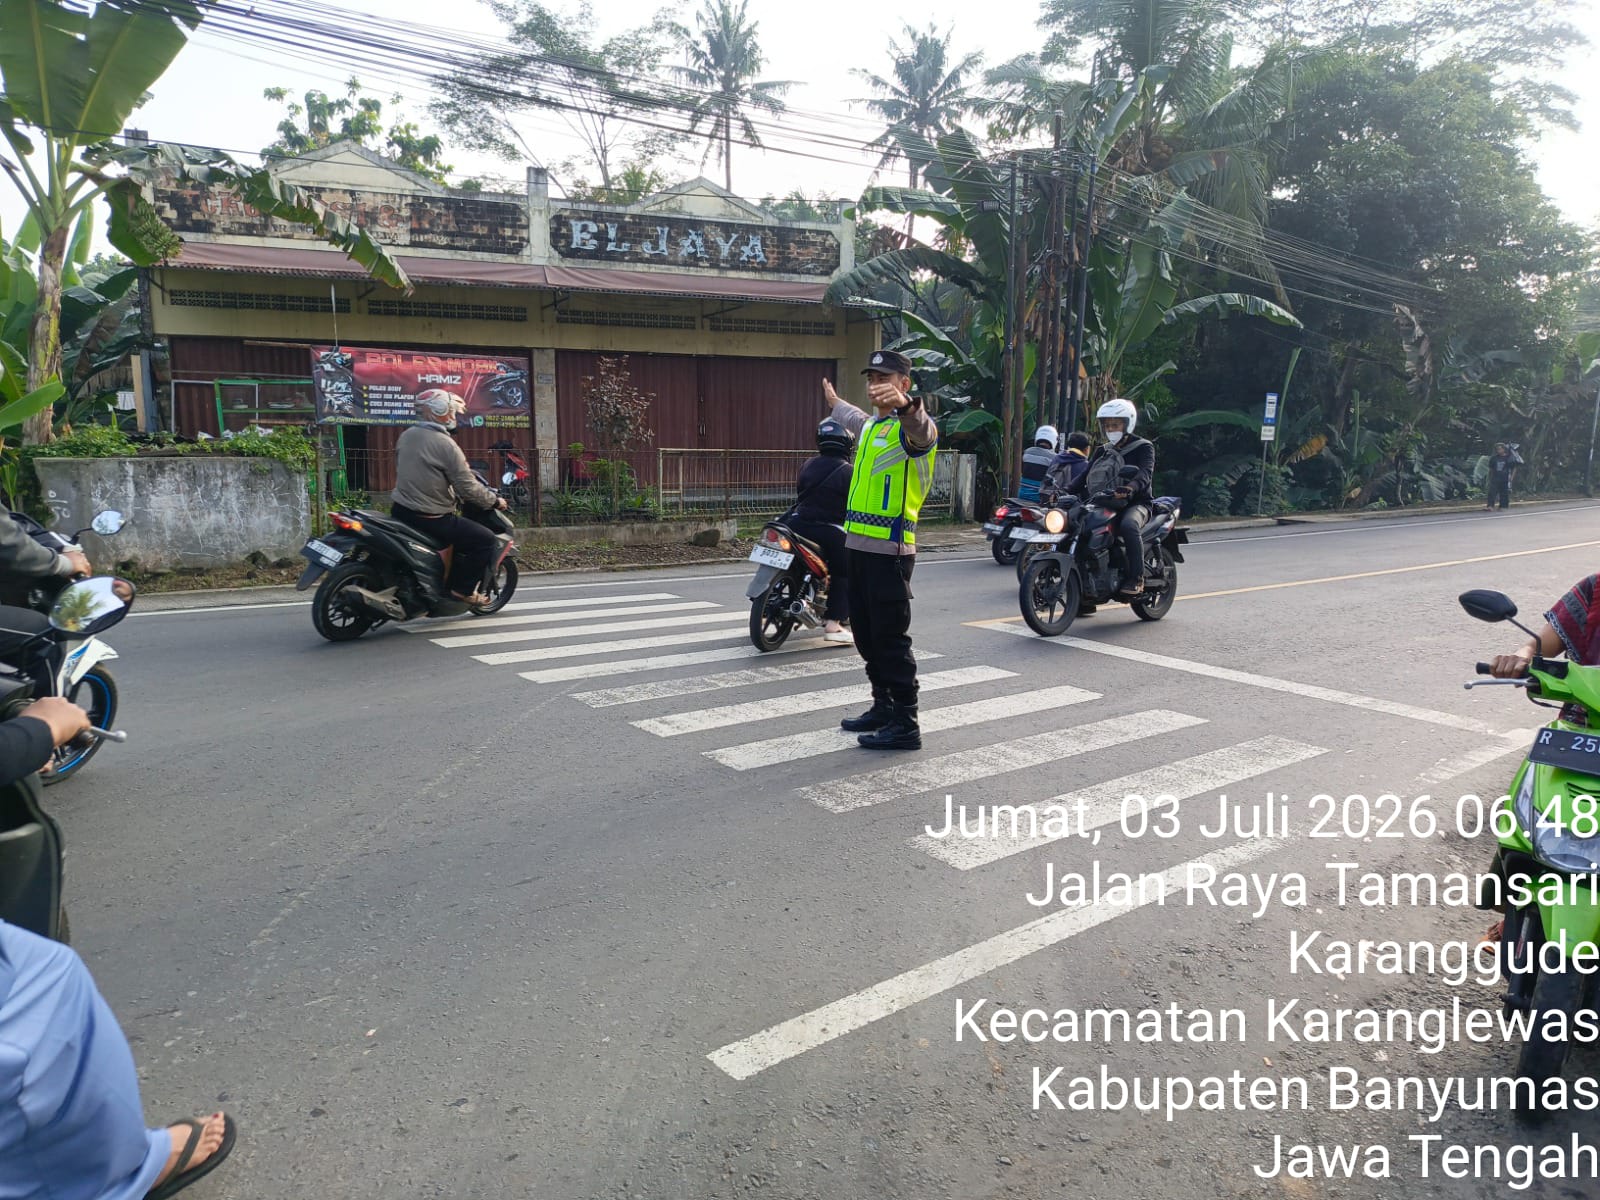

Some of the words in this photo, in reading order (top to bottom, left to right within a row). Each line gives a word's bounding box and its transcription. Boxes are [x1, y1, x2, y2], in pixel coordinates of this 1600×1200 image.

[642, 226, 767, 264] JAYA
[417, 373, 462, 385] HAMIZ
[1538, 730, 1553, 745] R
[1570, 736, 1600, 754] 25
